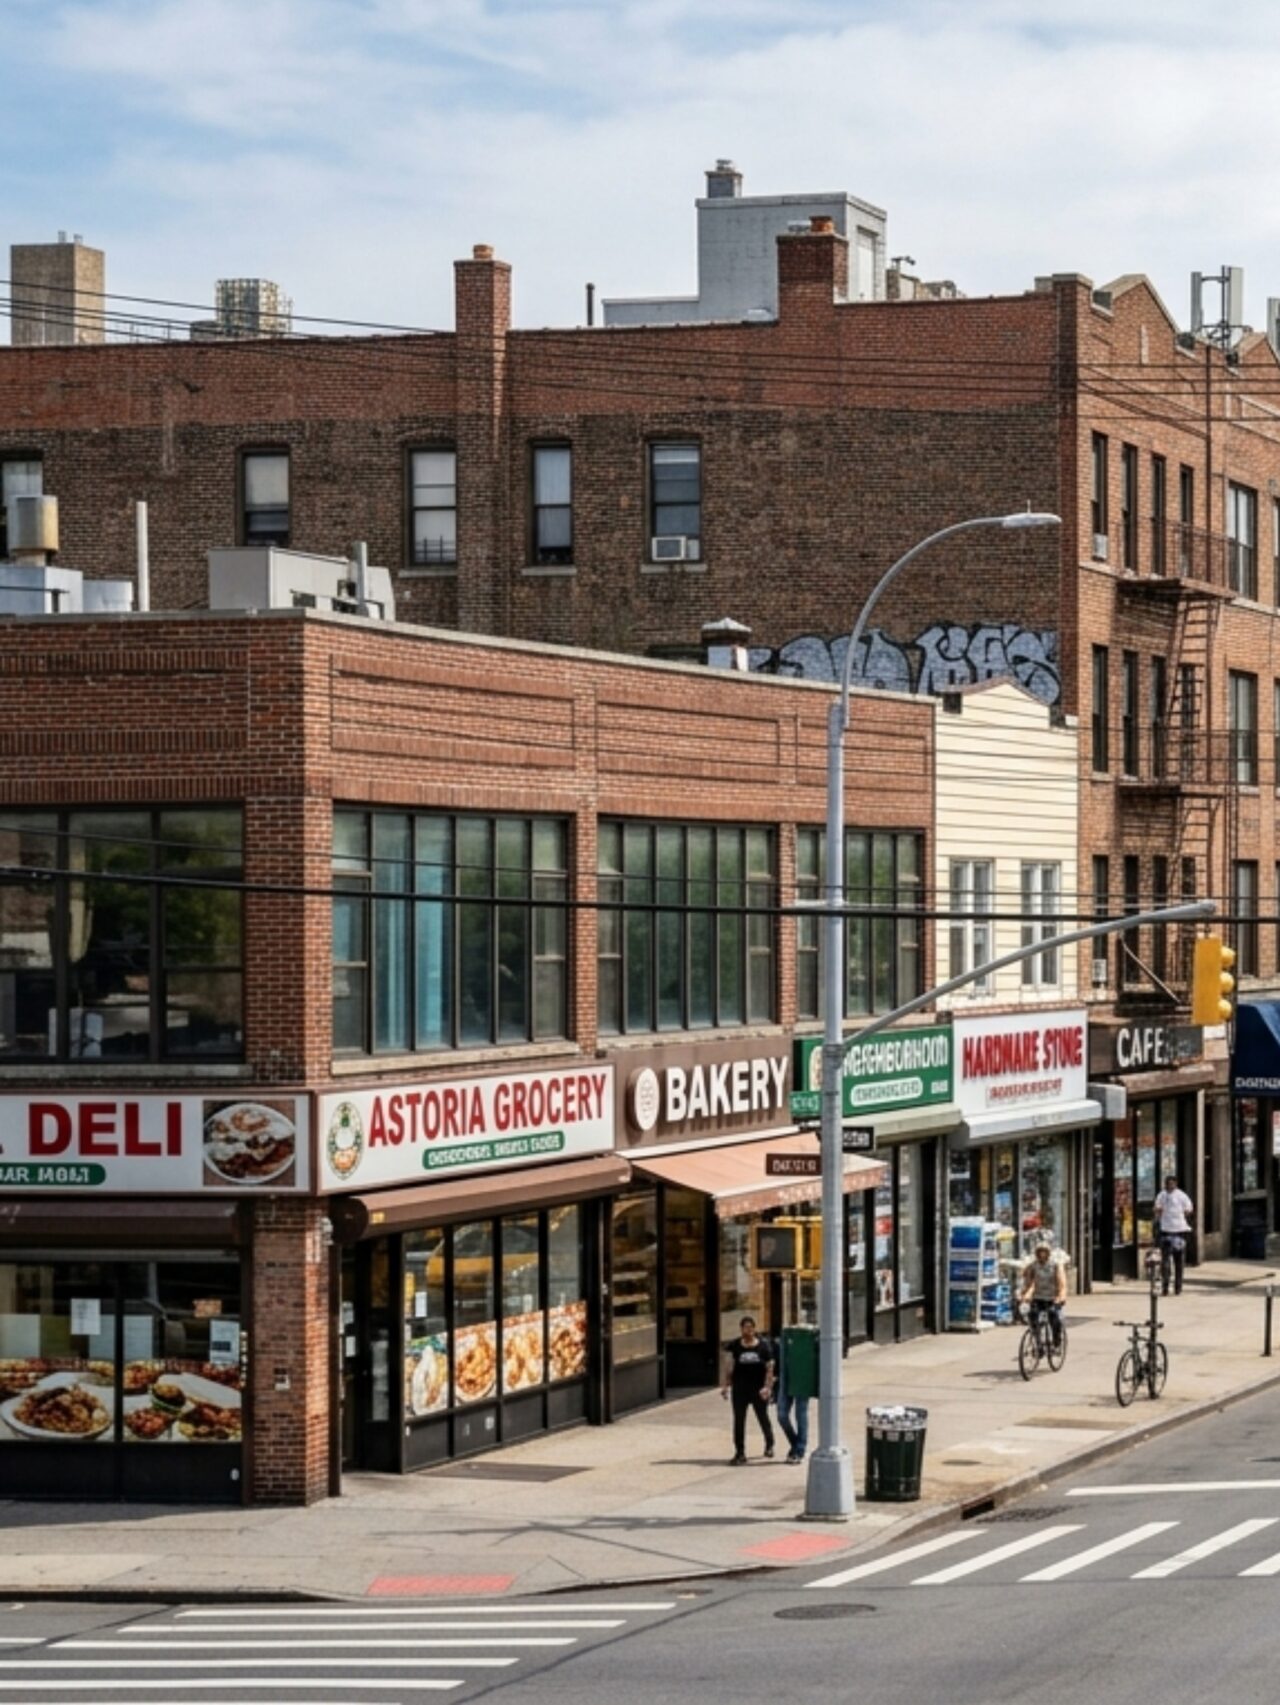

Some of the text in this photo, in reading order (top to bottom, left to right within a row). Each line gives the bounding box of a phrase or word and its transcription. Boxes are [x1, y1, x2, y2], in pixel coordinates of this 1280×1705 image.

[368, 1074, 606, 1147] ASTORIA GROCERY
[667, 1056, 788, 1121] BAKERY
[29, 1102, 182, 1156] DELI
